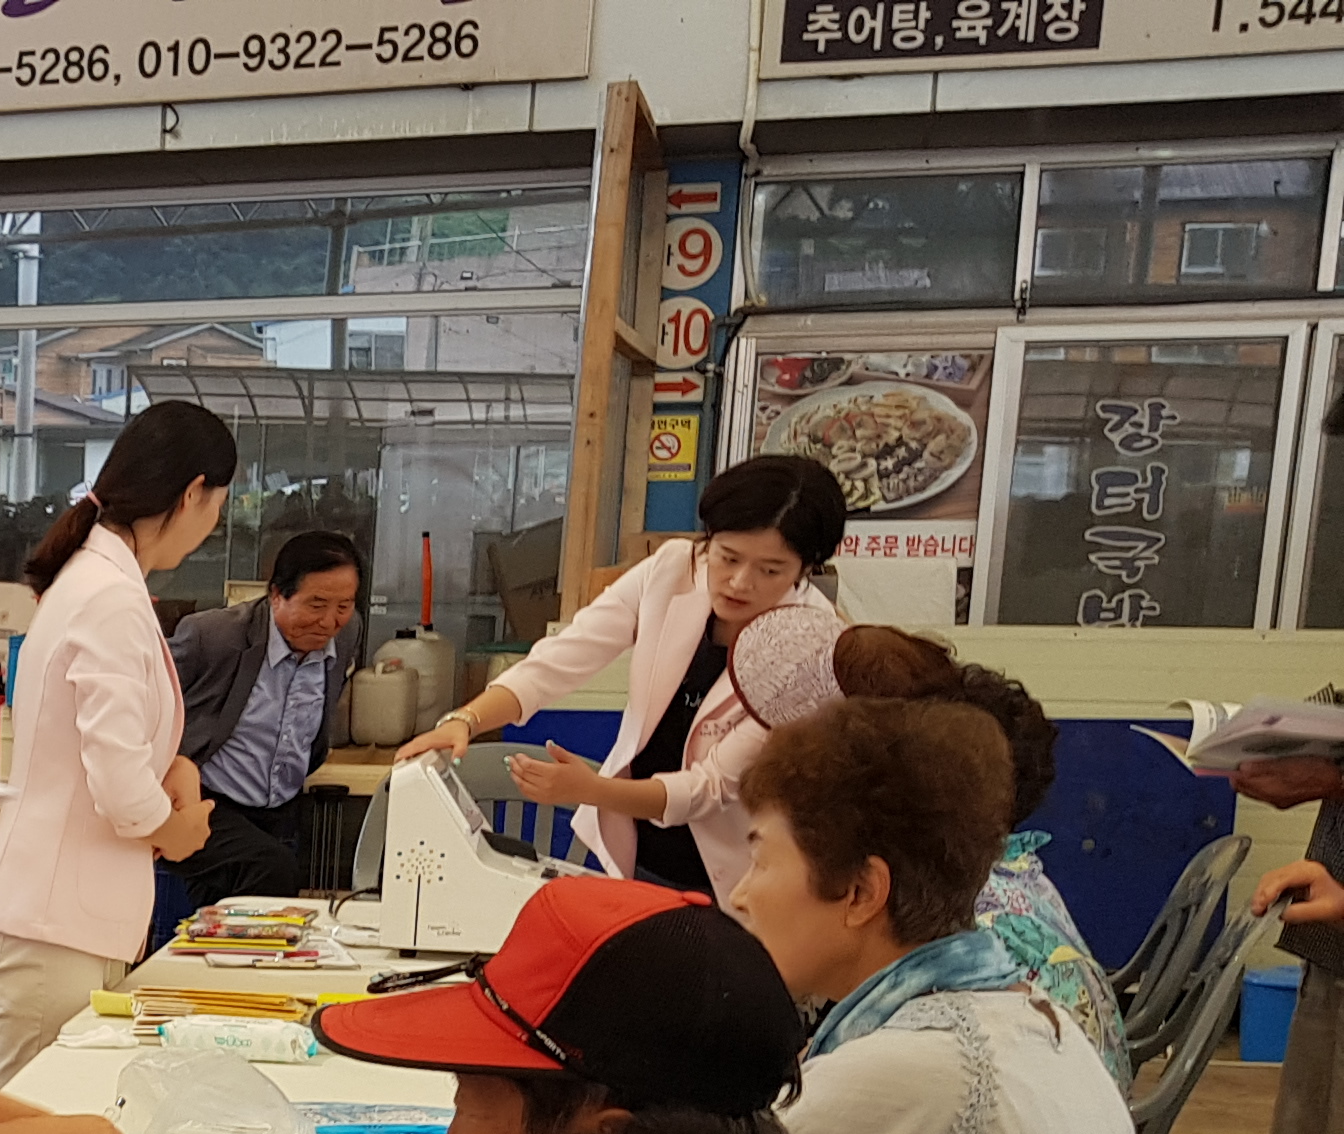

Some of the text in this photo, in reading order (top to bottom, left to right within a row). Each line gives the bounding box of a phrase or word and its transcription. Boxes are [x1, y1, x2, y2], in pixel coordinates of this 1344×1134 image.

[137, 20, 481, 80] 010-9322-5286
[676, 226, 714, 278] 9
[666, 307, 712, 358] 10
[835, 534, 976, 558] 약 주문 받습니다
